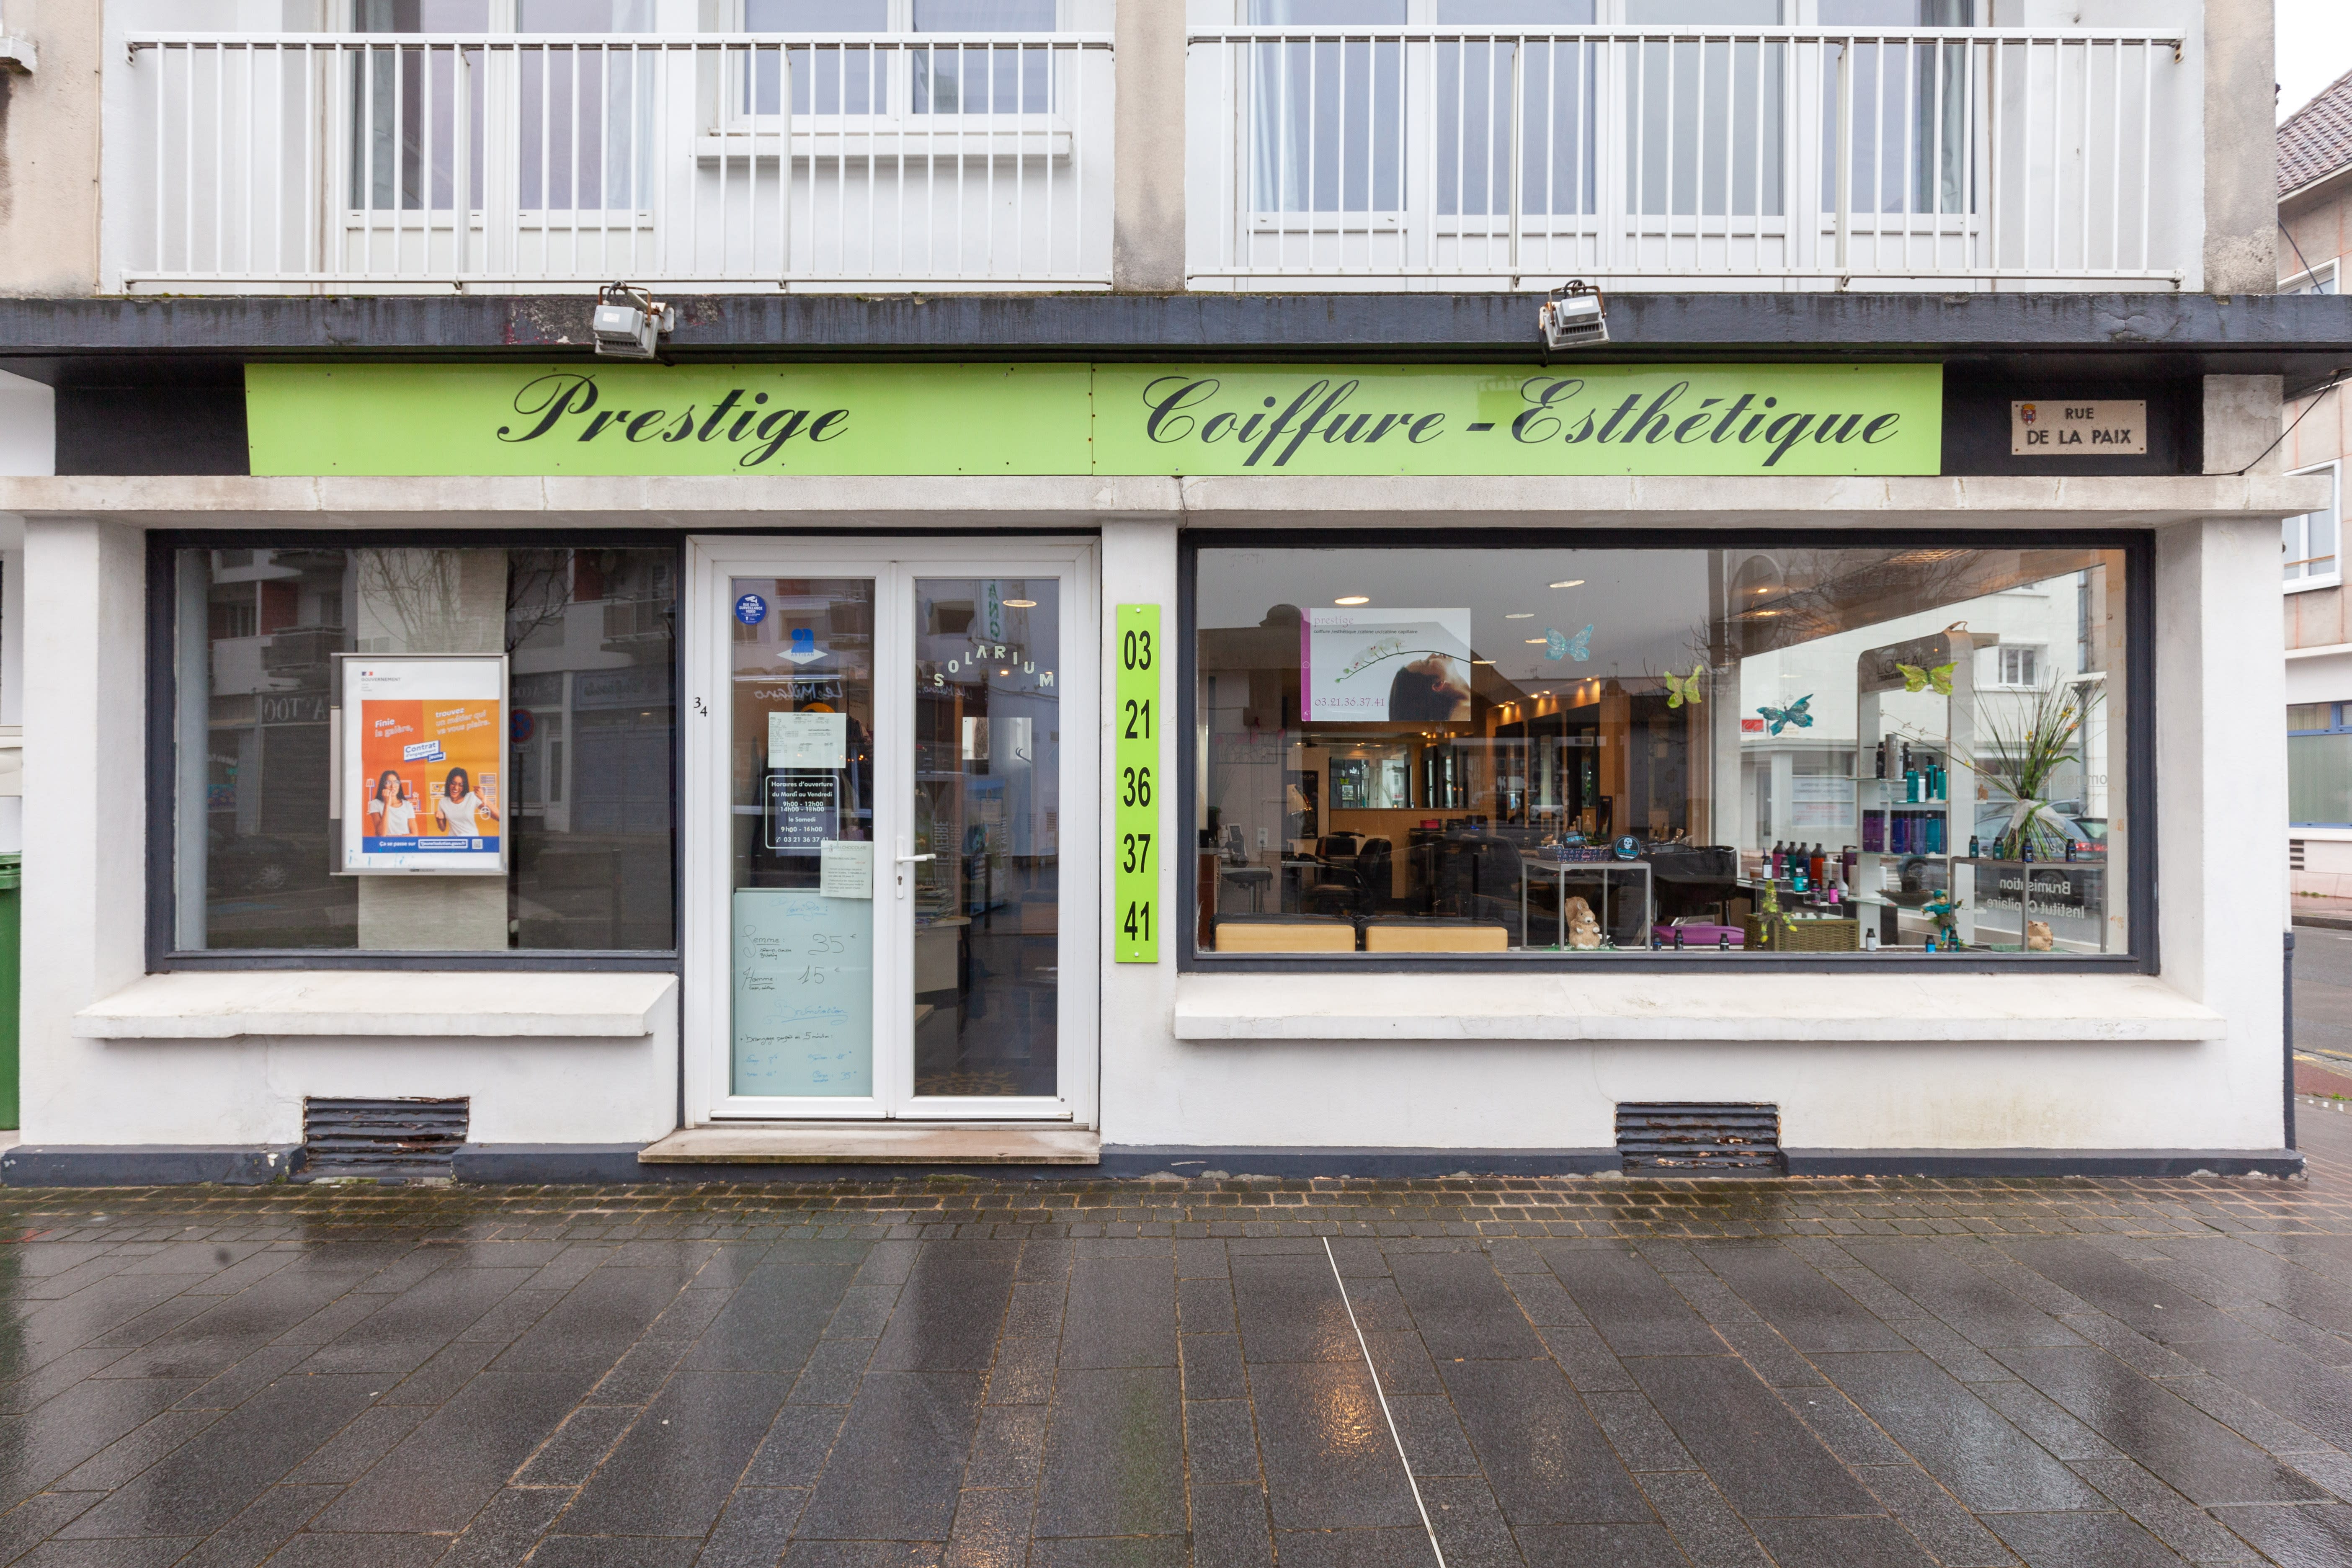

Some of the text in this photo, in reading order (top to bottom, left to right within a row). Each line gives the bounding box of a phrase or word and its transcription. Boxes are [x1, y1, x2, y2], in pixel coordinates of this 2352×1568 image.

[497, 373, 848, 466] Prestige
[1143, 377, 1446, 466] Coiffure
[1511, 379, 1900, 466] Esthétique
[2065, 408, 2094, 419] RUE
[2027, 430, 2131, 444] DE LA PAIX
[1314, 614, 1354, 628] prestige
[1124, 630, 1151, 670] 03
[934, 645, 1054, 687] SOLARIUM
[1315, 696, 1385, 707] 03.21.36.37.41
[436, 708, 464, 718] trouvez
[447, 714, 472, 725] métier
[474, 710, 486, 720] qui
[1124, 699, 1151, 739] 21
[375, 719, 395, 728] Finie
[385, 725, 413, 737] galère,
[467, 720, 490, 731] plaire.
[405, 743, 436, 753] Contrat
[405, 748, 436, 758] d'engagement
[1123, 767, 1151, 807] 36
[1123, 833, 1151, 873] 37
[1124, 901, 1150, 941] 41
[742, 925, 780, 958] Femme
[808, 934, 844, 956] 35
[798, 965, 825, 984] 15
